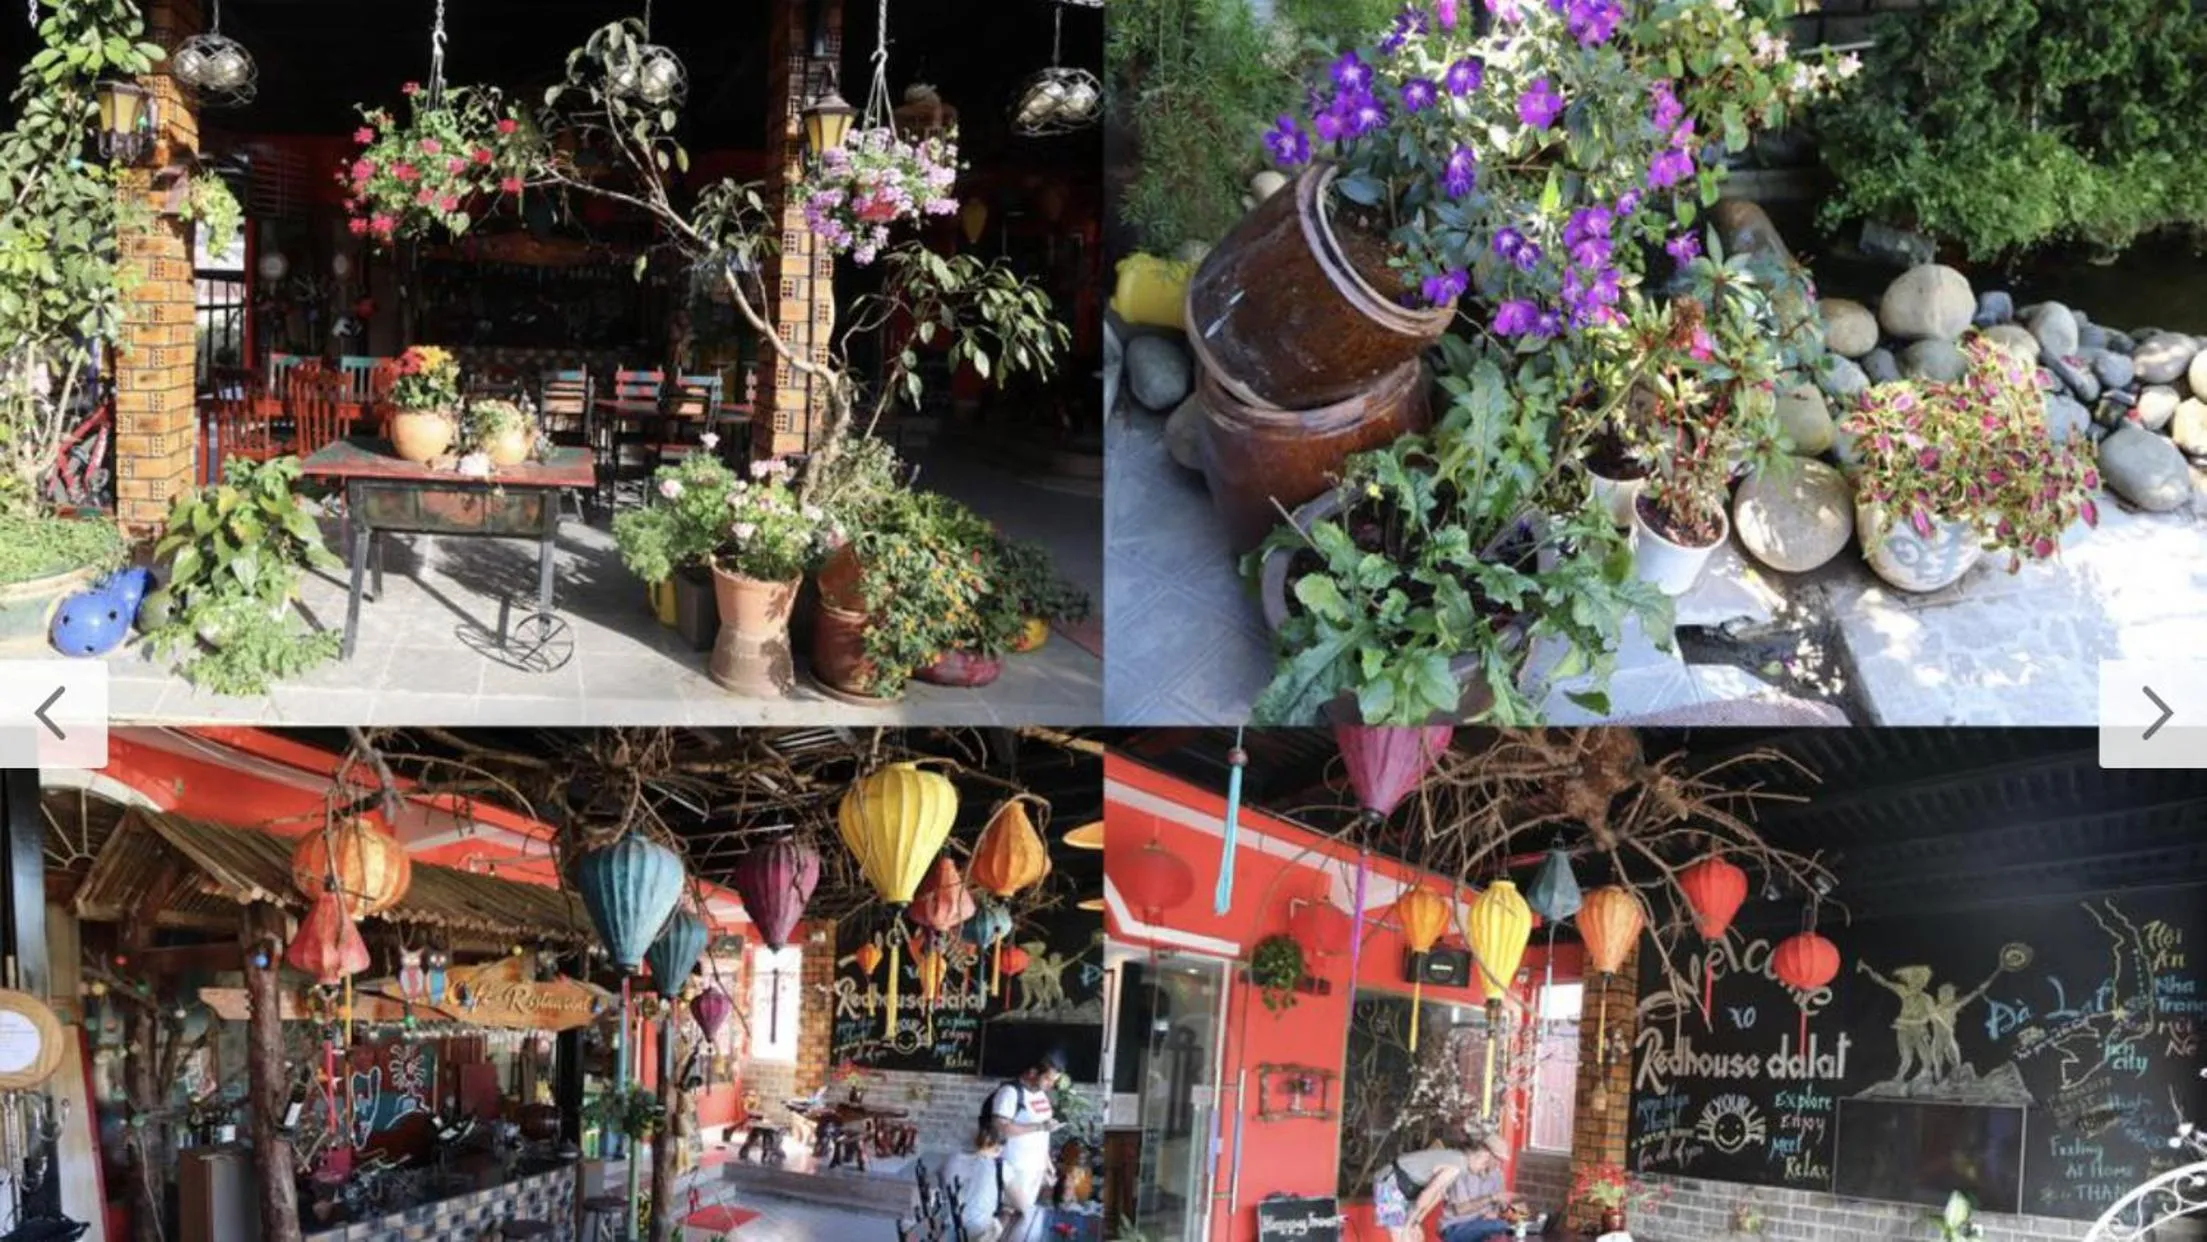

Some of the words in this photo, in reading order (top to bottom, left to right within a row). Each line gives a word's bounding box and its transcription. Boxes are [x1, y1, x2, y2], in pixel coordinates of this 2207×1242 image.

[1635, 1026, 1760, 1095] Redhouse
[1766, 1032, 1852, 1079] dalat
[1774, 1082, 1833, 1115] Explore
[1780, 1113, 1826, 1144] Enjoy
[1784, 1148, 1829, 1180] Relax
